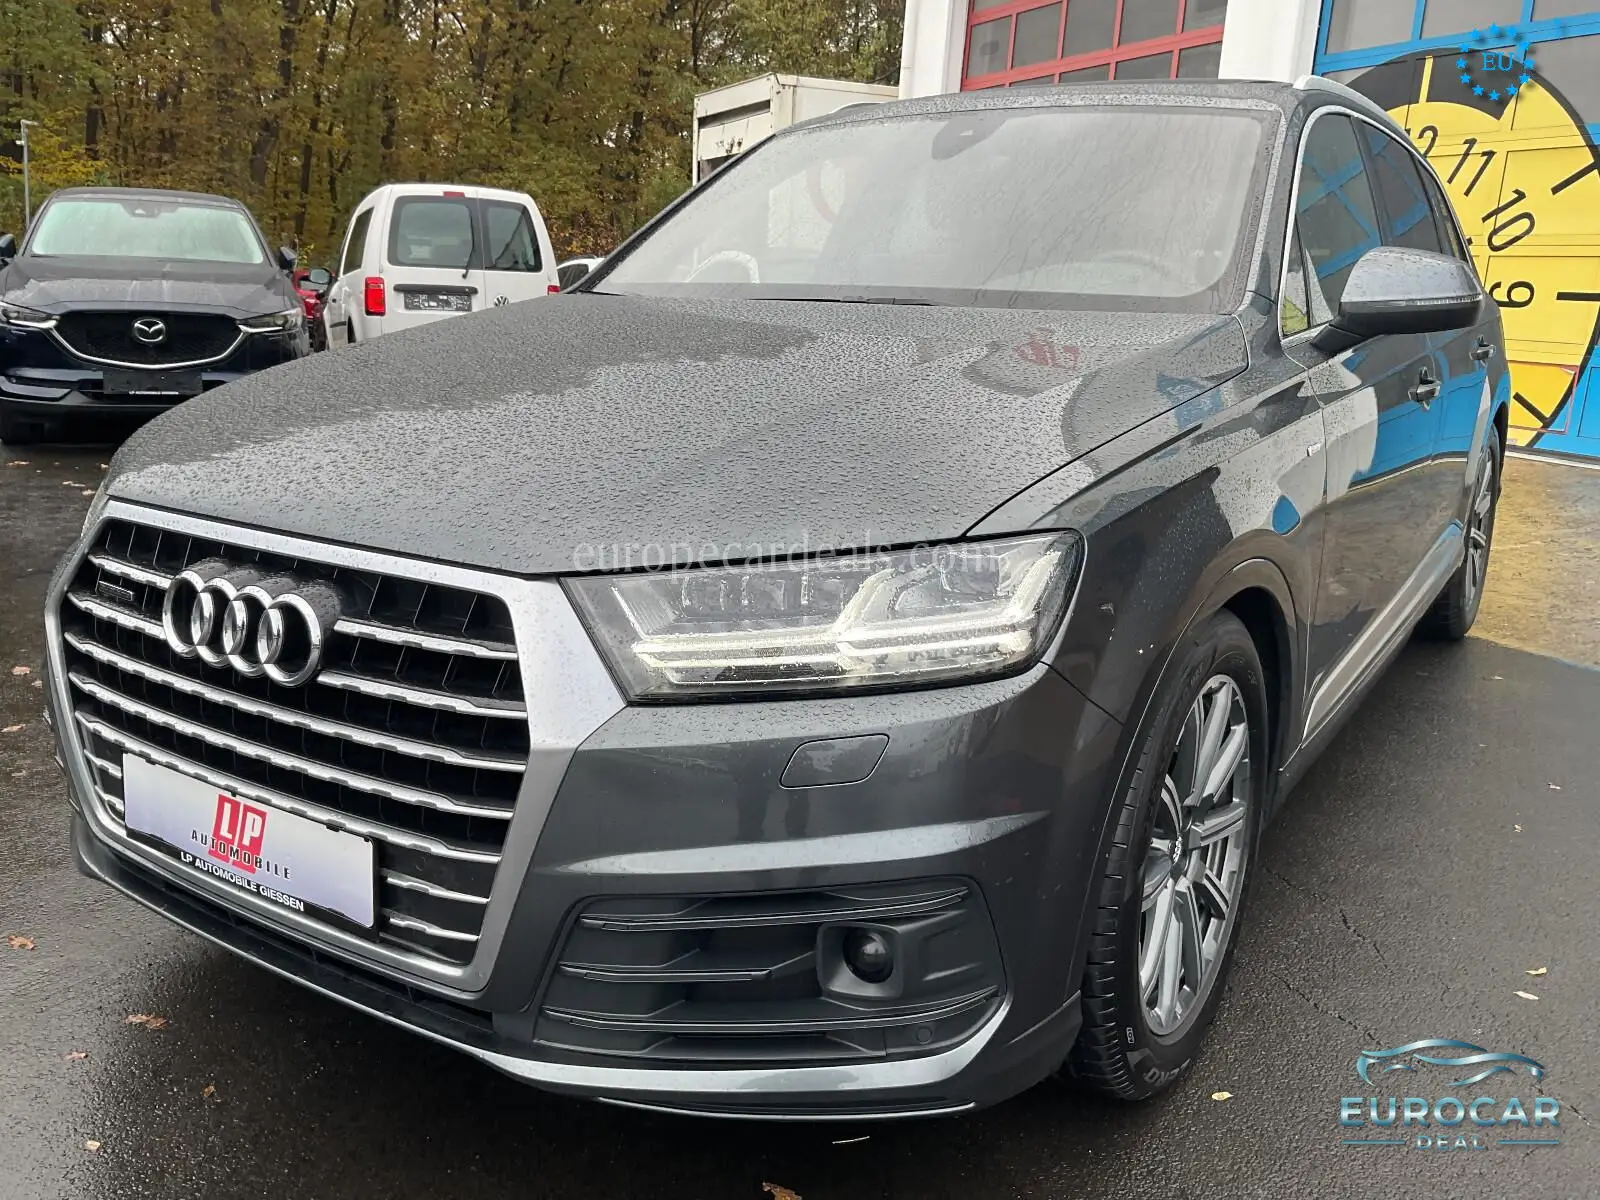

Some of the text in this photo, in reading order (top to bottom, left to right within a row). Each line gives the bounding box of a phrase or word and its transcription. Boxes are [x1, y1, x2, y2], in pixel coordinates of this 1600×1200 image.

[1446, 137, 1496, 196] 11
[1481, 188, 1535, 252] 10
[220, 802, 263, 847] LP
[180, 851, 305, 912] LP AUTOMOBILE GIESSEN
[191, 829, 291, 880] AUTOMOBILE
